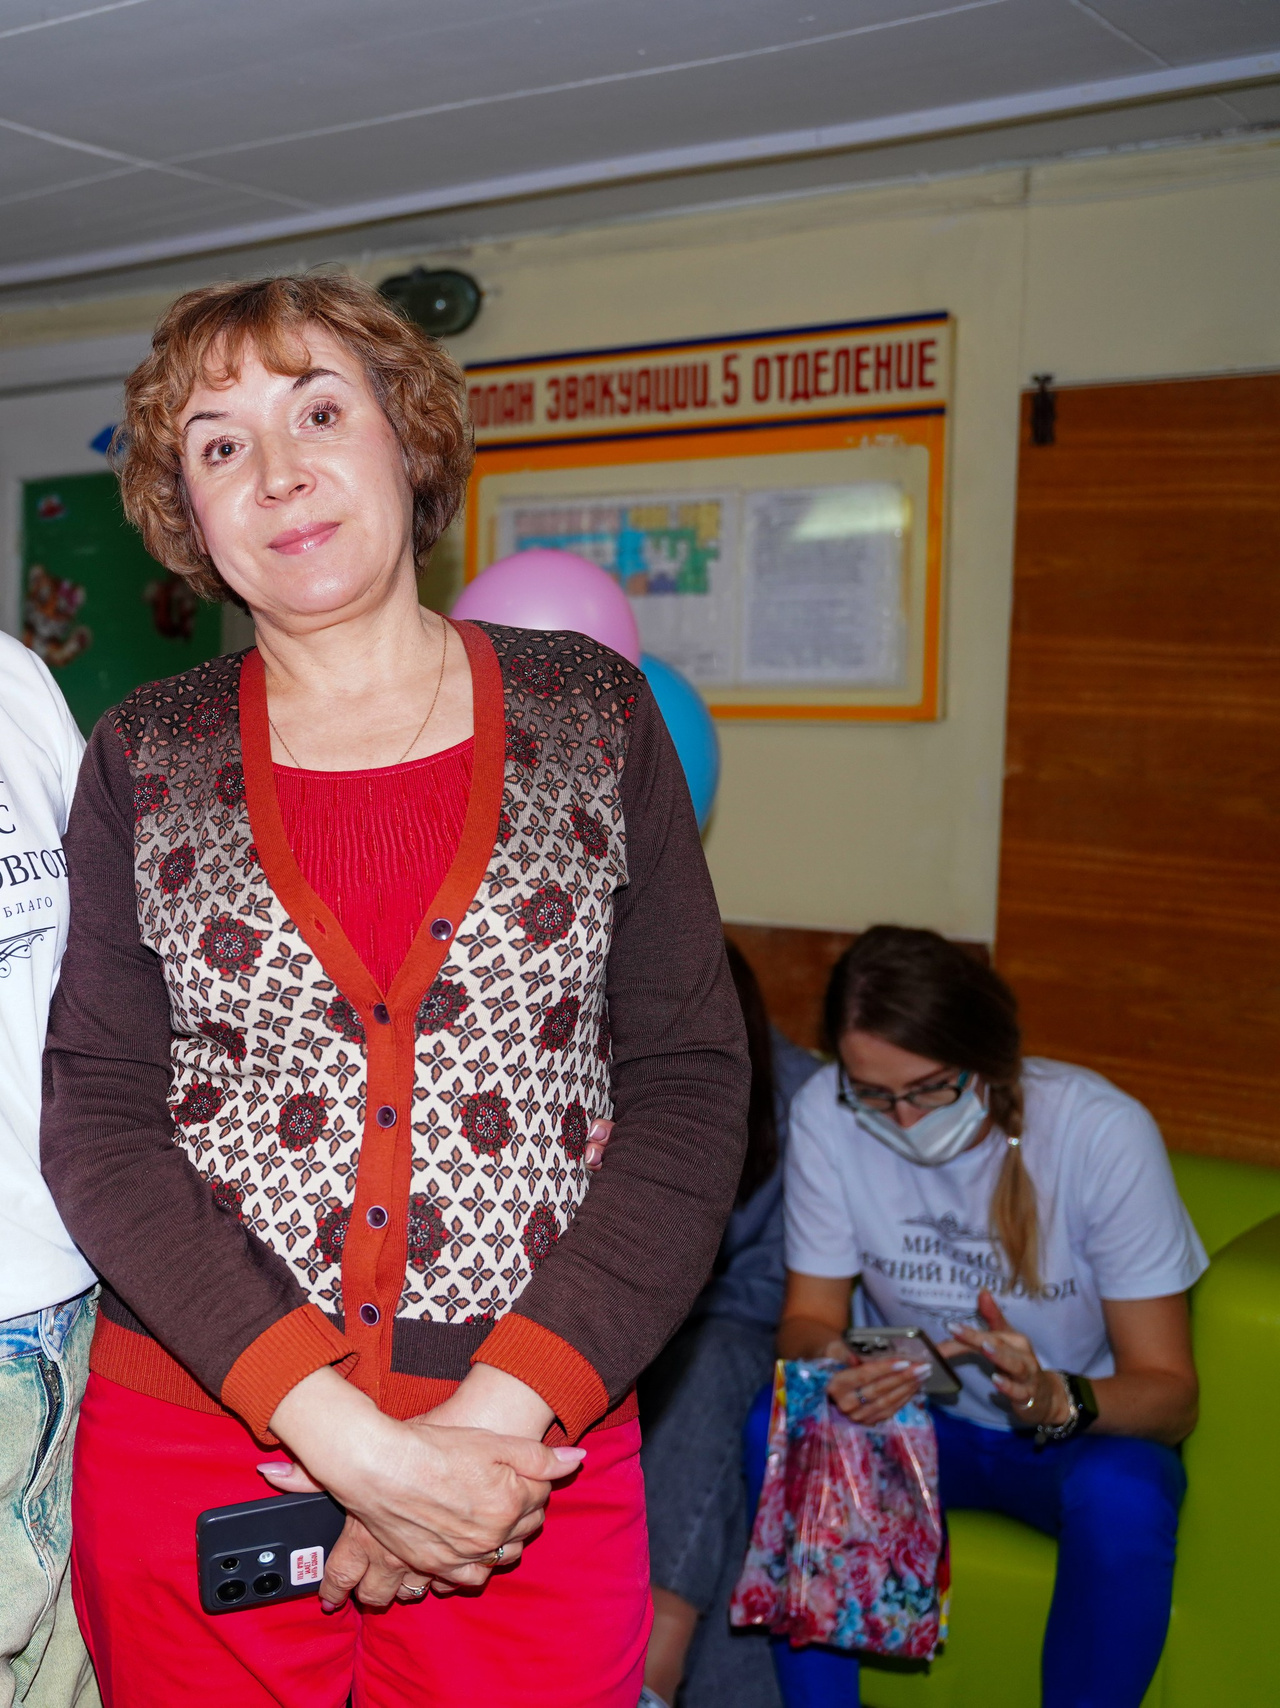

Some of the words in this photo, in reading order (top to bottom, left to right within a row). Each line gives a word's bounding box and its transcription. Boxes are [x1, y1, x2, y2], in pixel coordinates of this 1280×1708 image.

[469, 379, 534, 428] ПЛАН
[722, 353, 740, 407] 5
[752, 339, 937, 405] ОТДЕЛЕНИЕ
[3, 896, 53, 918] БЛАГО
